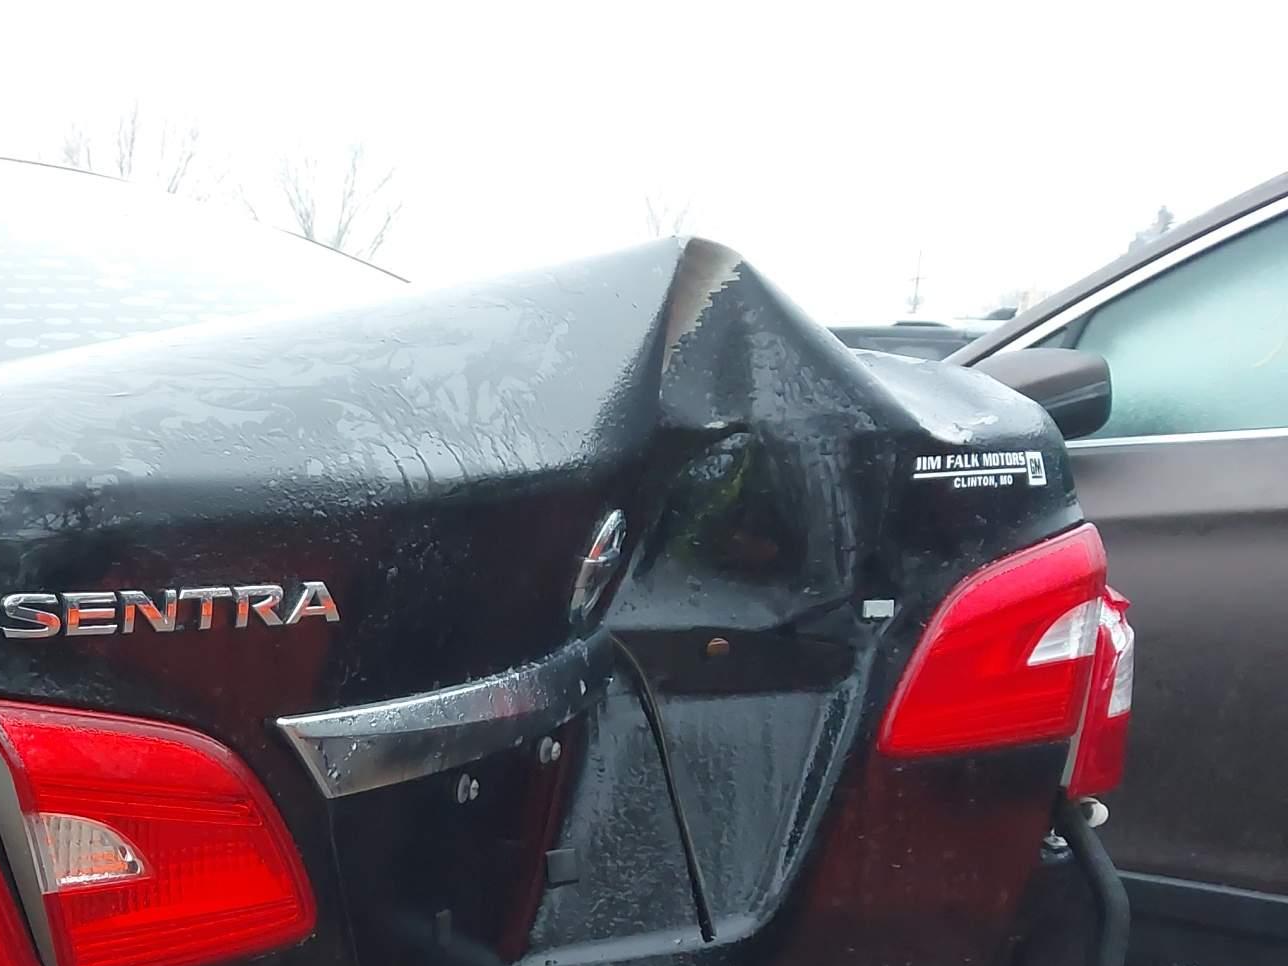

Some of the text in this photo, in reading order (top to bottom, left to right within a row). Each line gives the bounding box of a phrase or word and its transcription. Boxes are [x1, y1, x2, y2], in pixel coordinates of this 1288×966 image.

[915, 451, 1026, 471] JIM FALK MOTORS
[953, 474, 1013, 488] CLINTON, MO
[0, 581, 341, 639] SENTRA
